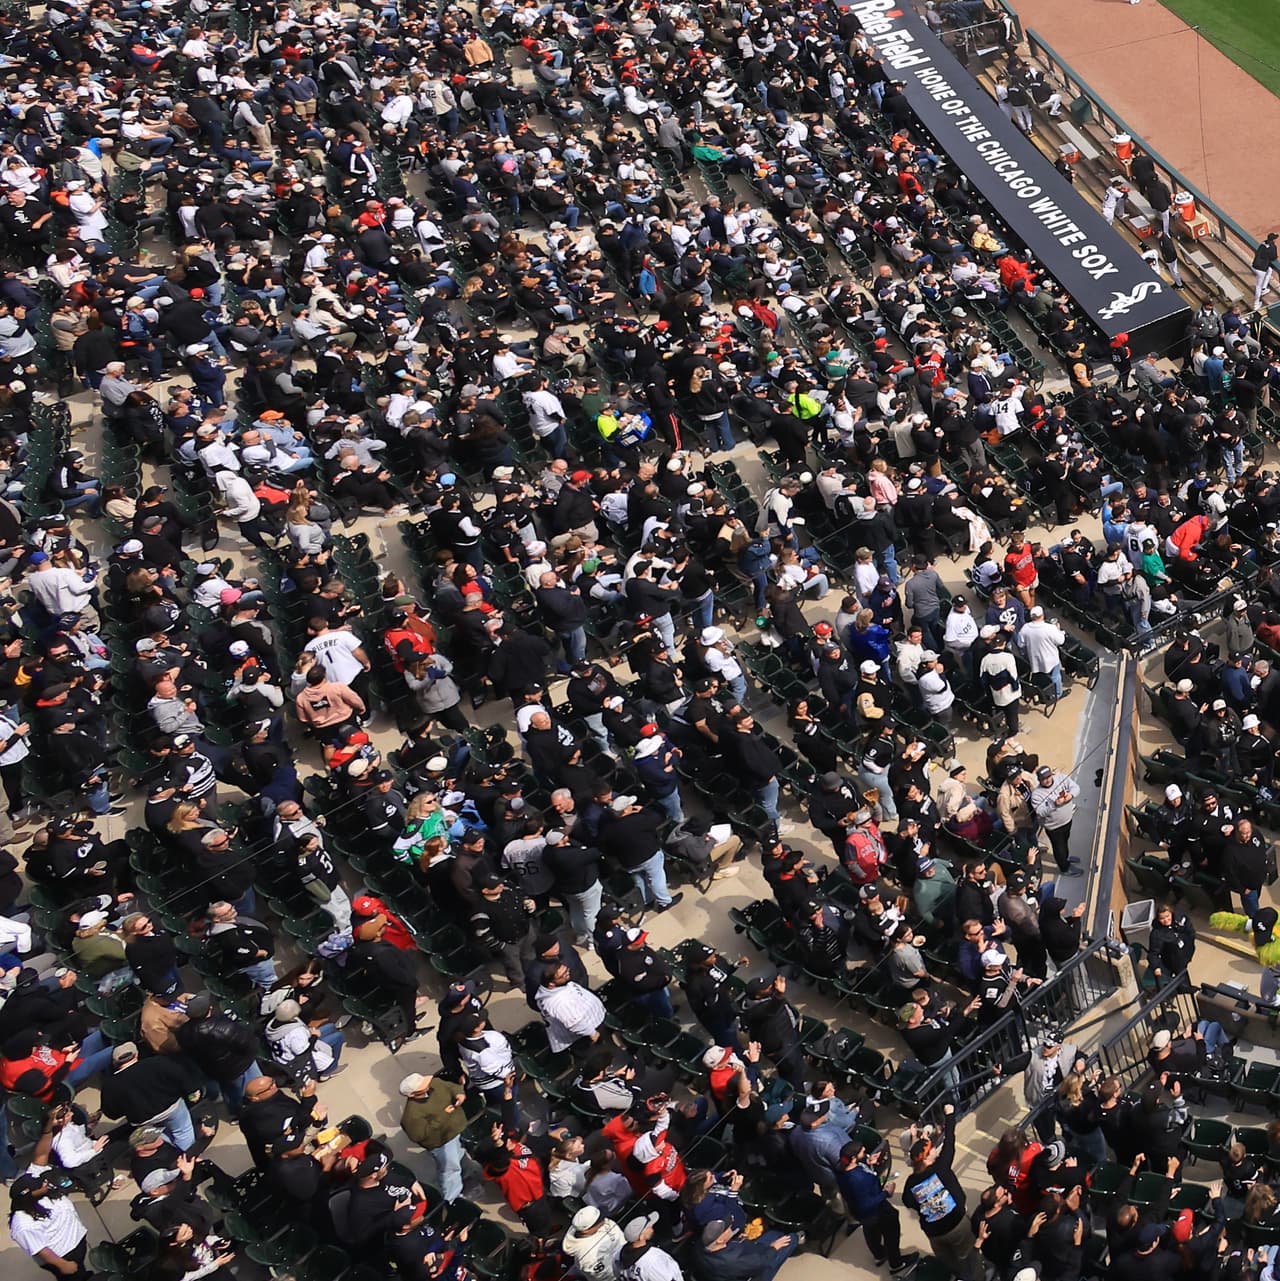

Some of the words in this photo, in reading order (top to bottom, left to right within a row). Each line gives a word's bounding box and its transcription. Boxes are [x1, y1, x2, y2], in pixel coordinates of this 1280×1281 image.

[873, 29, 922, 69] Field
[914, 57, 946, 103] HOME
[941, 95, 969, 120] OF
[955, 116, 989, 145] THE
[977, 140, 1040, 199] CHICAGO
[1028, 196, 1087, 247] WHITE
[1072, 242, 1119, 280] SOX
[996, 402, 1008, 414] 14
[1130, 538, 1139, 552] 8
[325, 650, 333, 664] 1
[514, 861, 540, 876] 56
